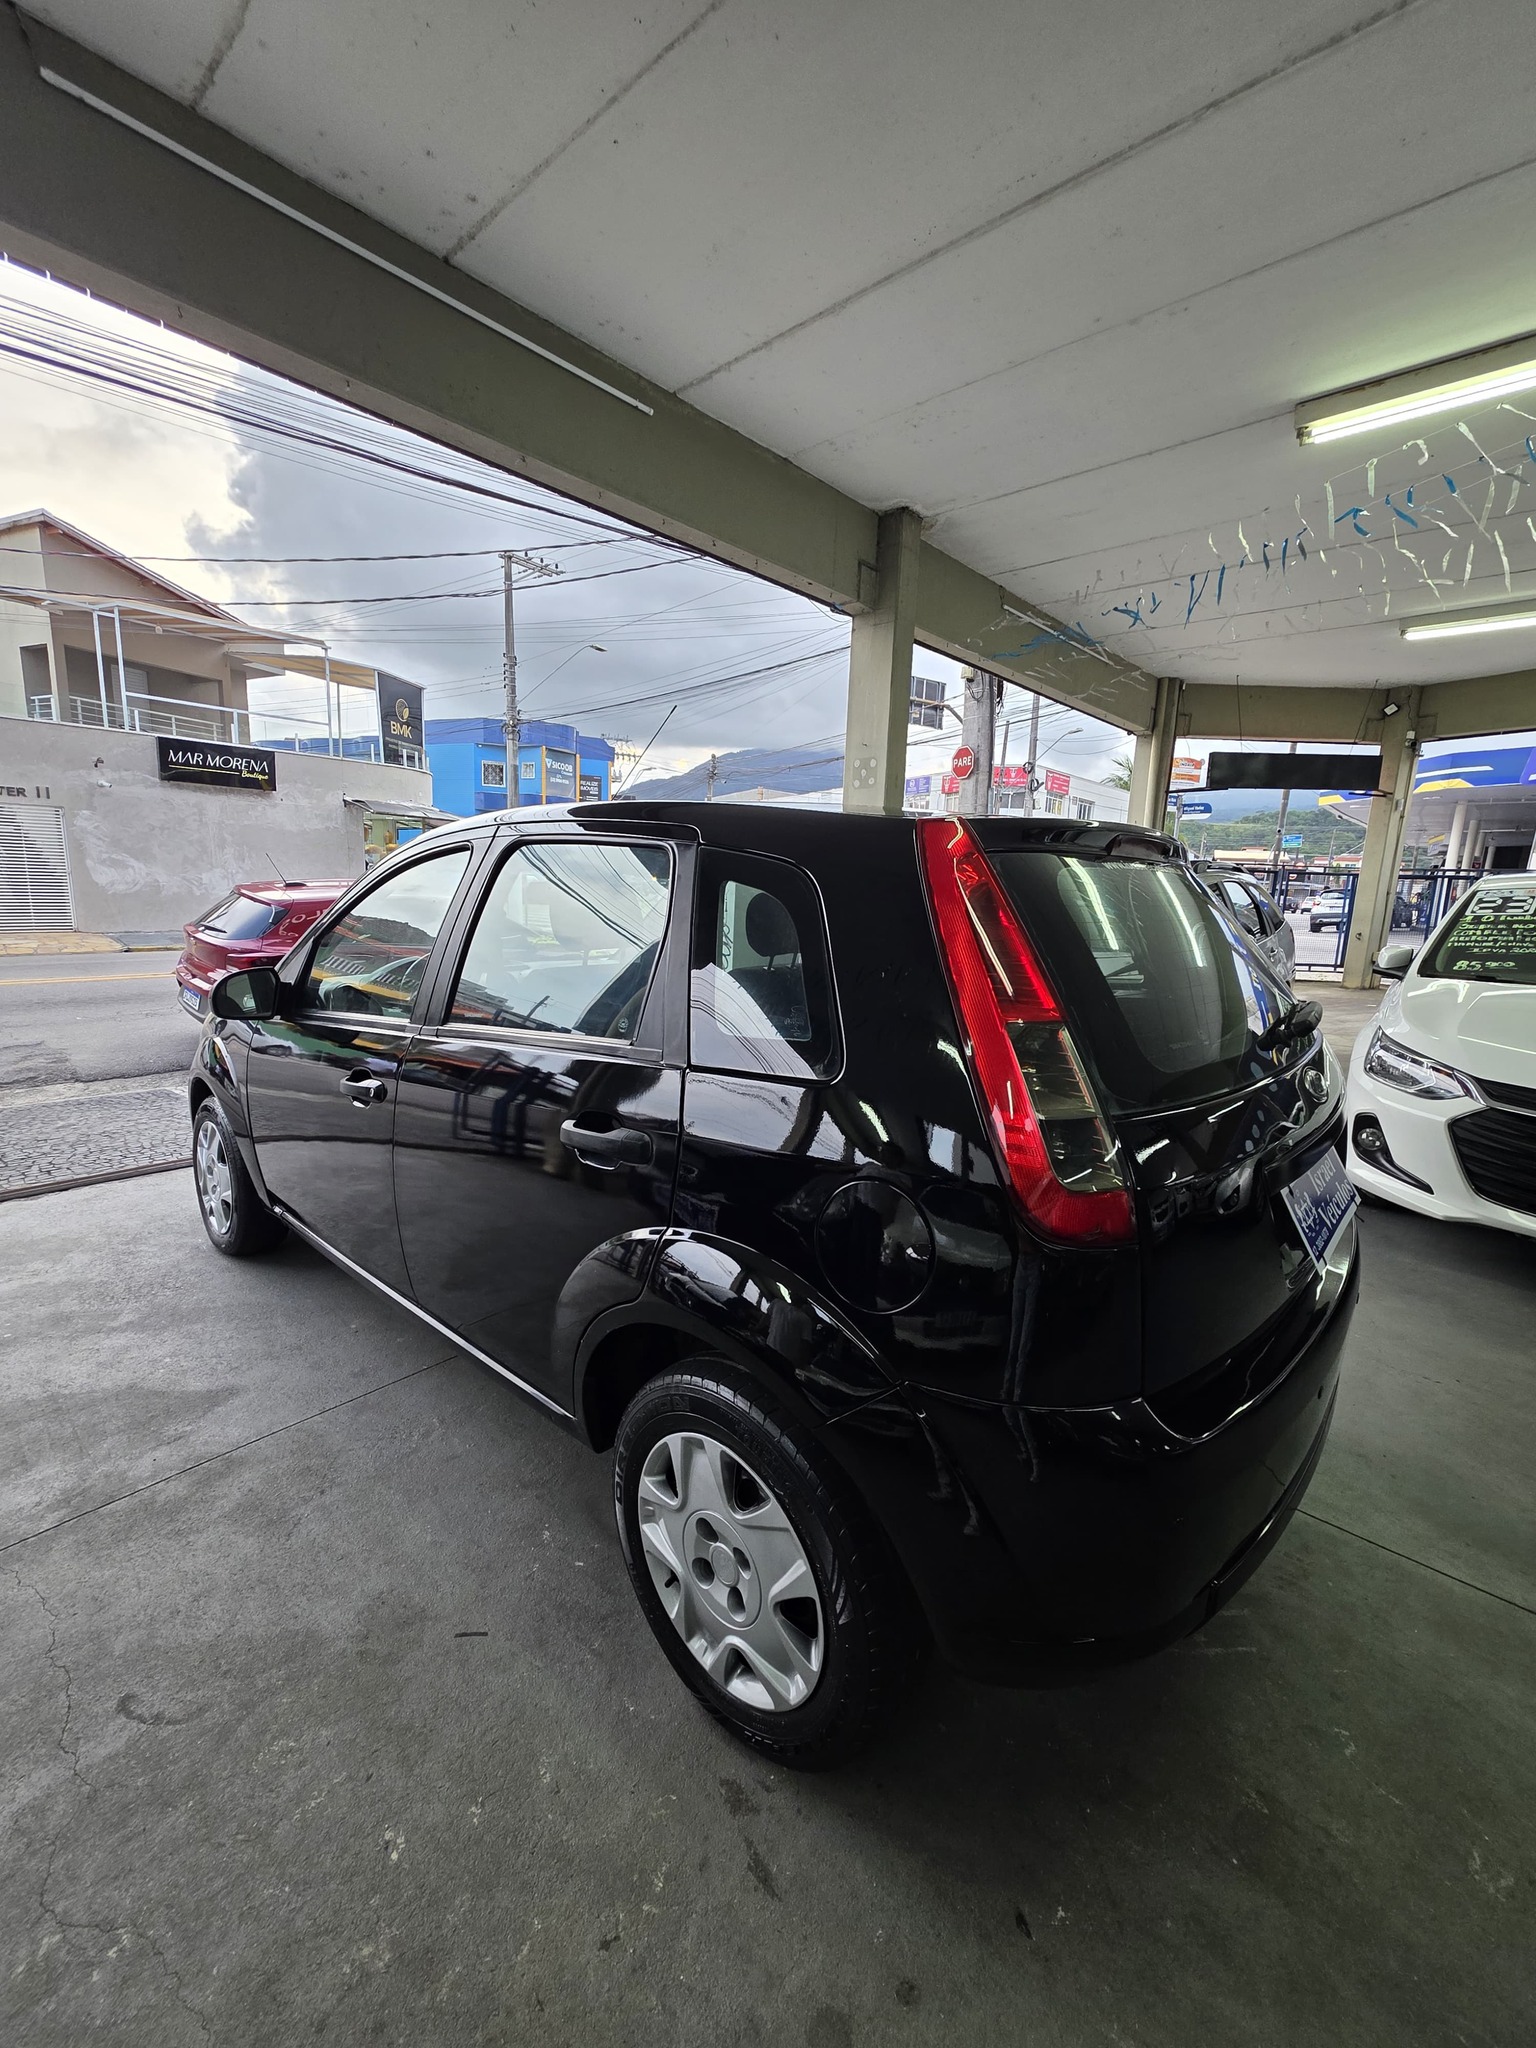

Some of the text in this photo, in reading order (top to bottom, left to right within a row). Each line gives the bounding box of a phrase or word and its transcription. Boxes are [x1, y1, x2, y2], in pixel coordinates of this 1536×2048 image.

[390, 720, 412, 739] BMK
[168, 749, 269, 773] MAR MORENA
[551, 760, 573, 772] SICOOB
[953, 755, 972, 768] PARE
[241, 769, 269, 781] Boutique
[1472, 896, 1534, 913] 23
[1306, 1153, 1336, 1196] Israel
[1318, 1180, 1354, 1230] Veículos
